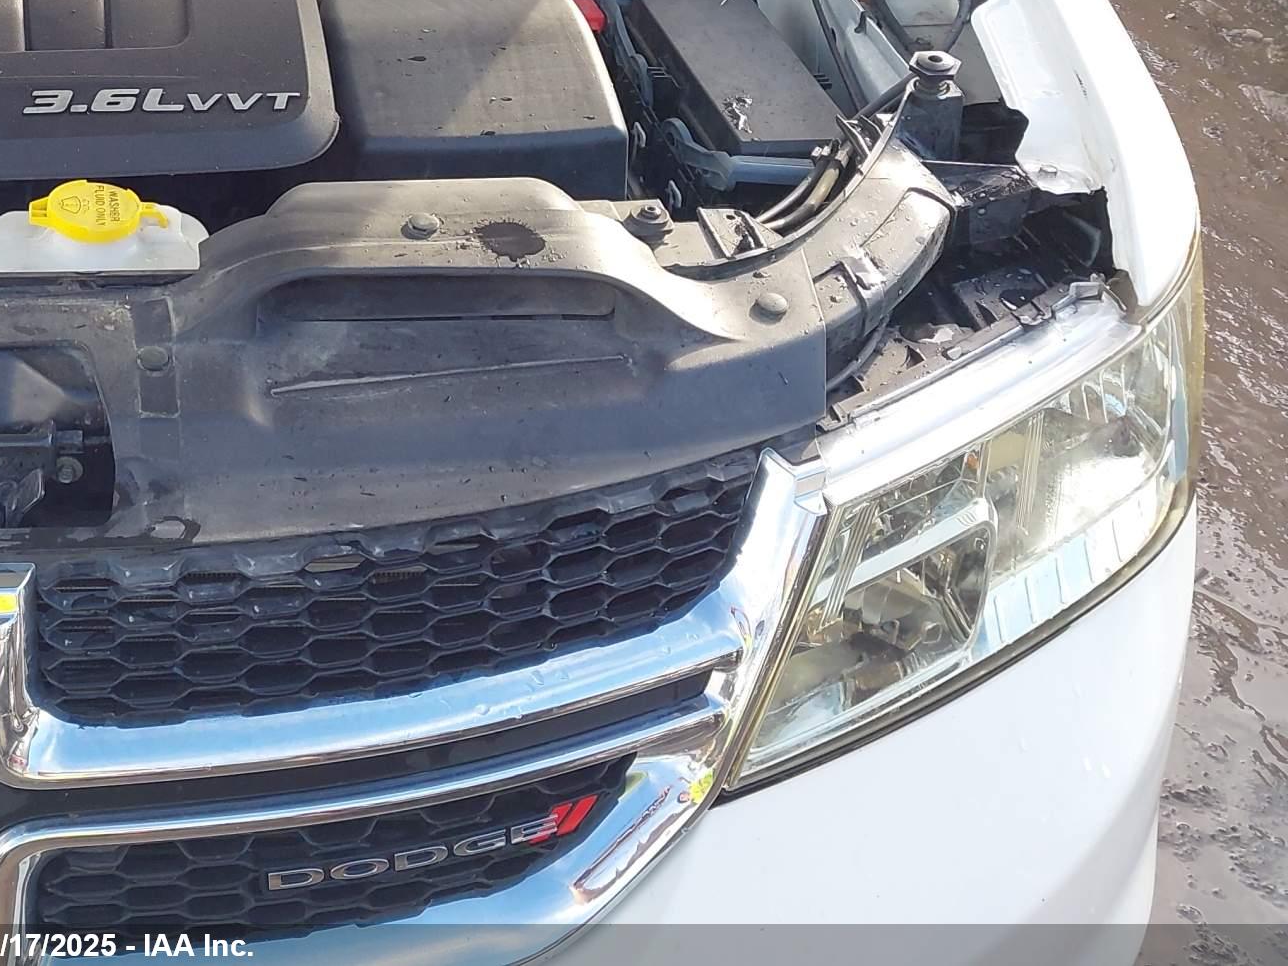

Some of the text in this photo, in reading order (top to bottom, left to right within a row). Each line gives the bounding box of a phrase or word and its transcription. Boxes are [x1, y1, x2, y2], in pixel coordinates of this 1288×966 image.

[94, 185, 106, 226] FLUID ONLY
[108, 191, 120, 222] WASHER
[268, 814, 559, 891] DODGE
